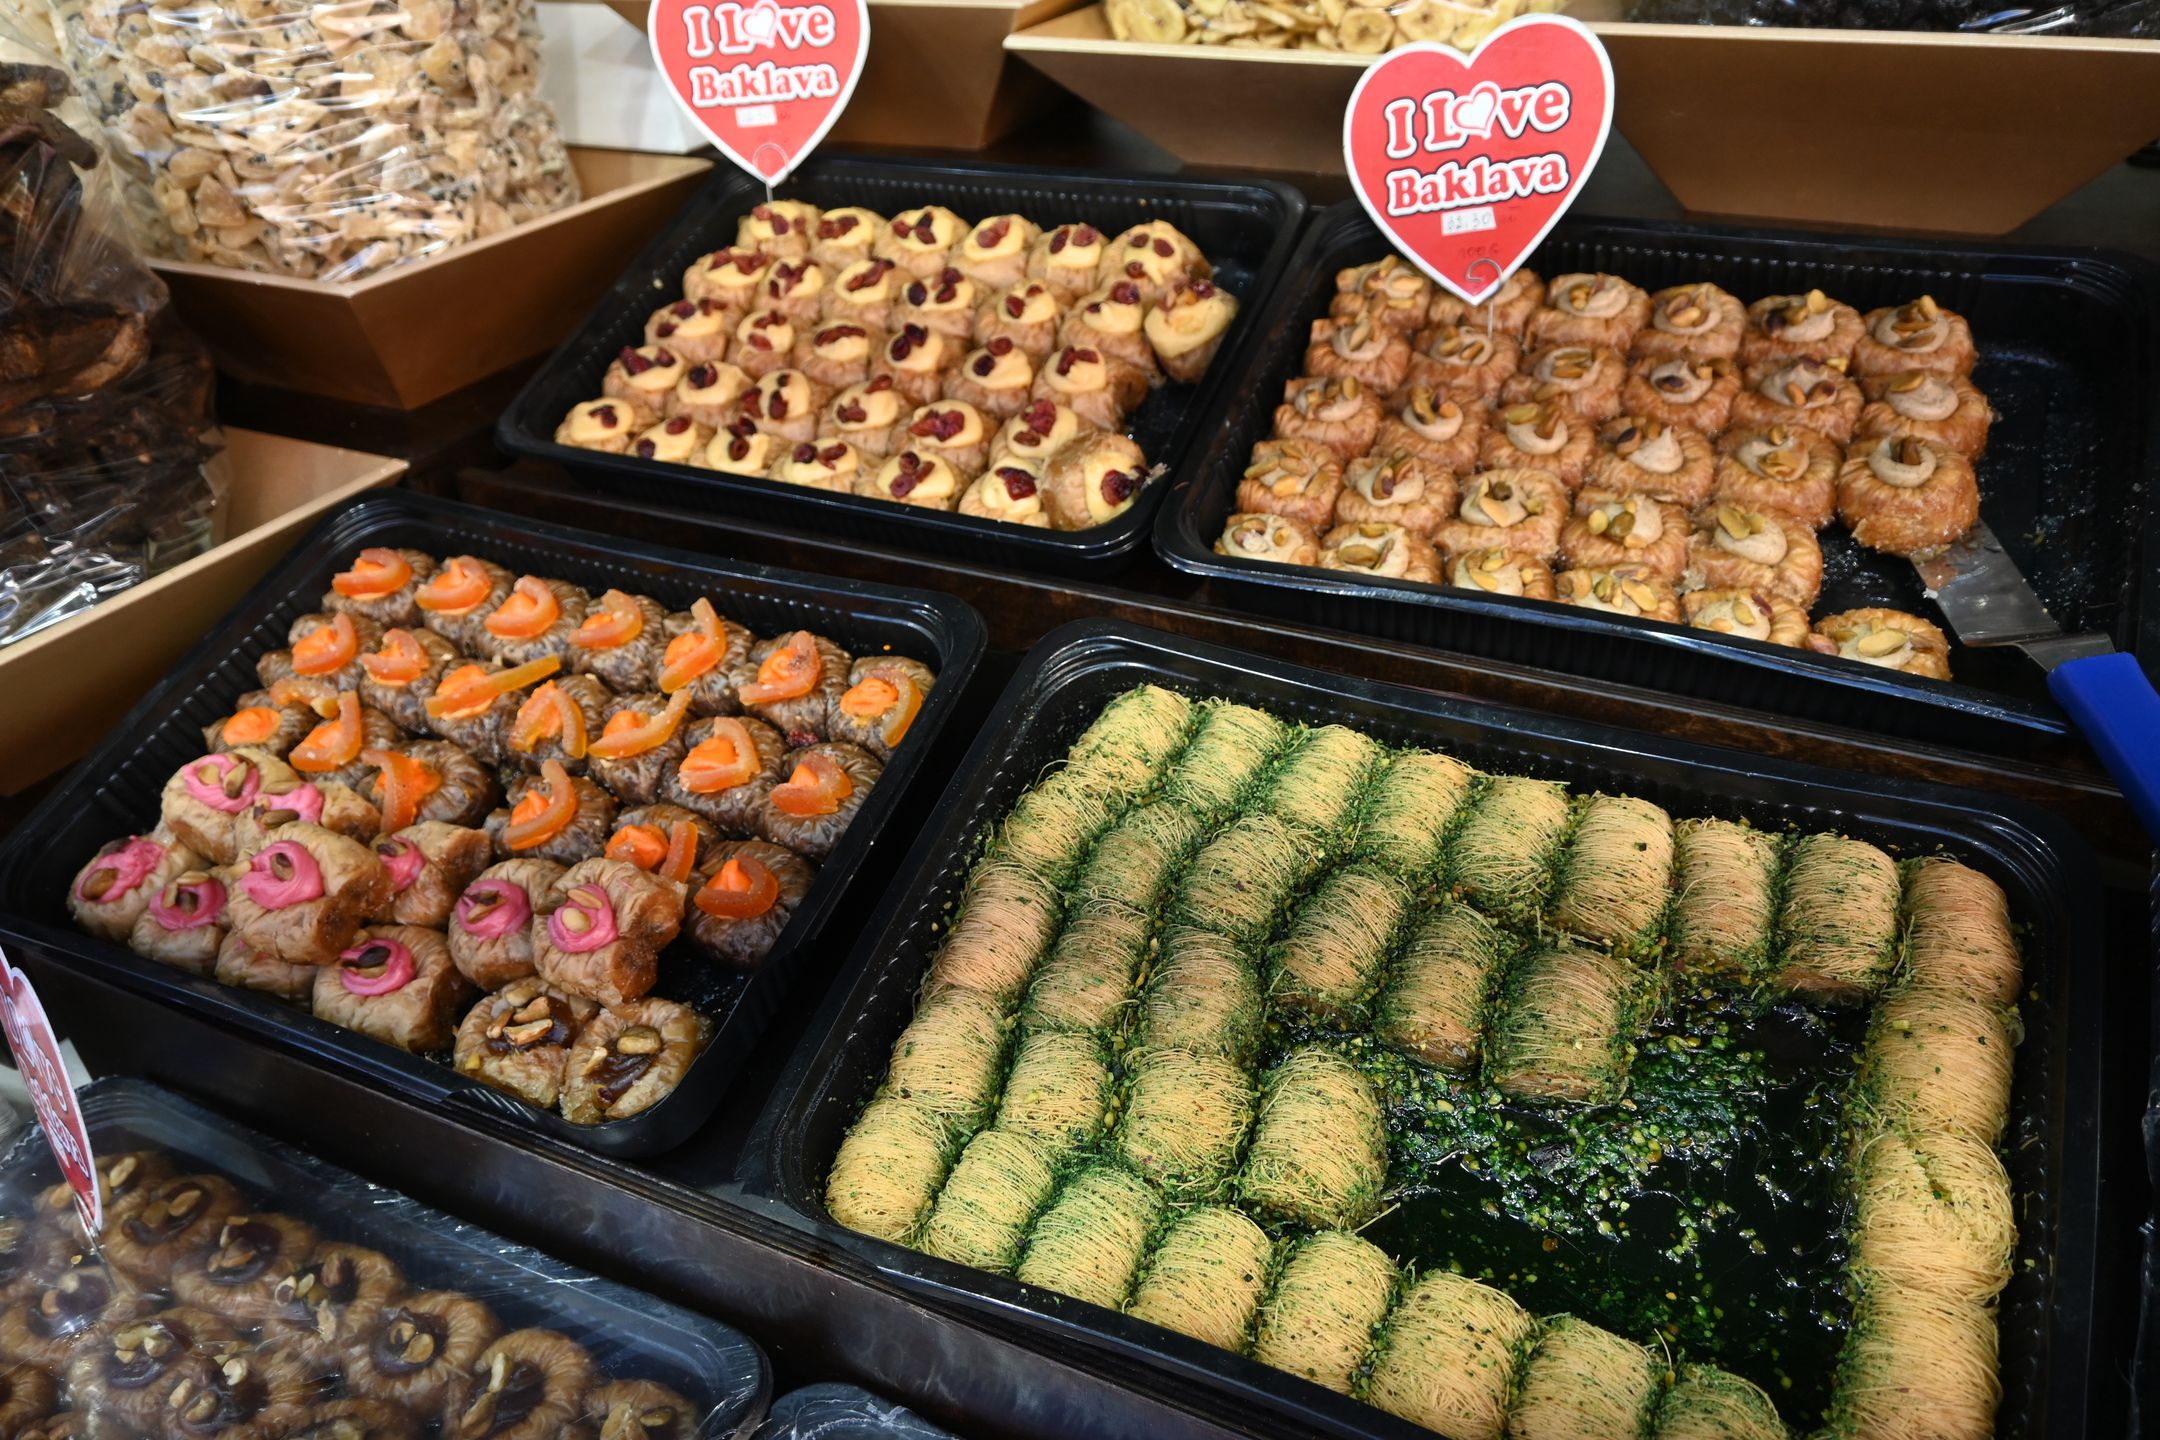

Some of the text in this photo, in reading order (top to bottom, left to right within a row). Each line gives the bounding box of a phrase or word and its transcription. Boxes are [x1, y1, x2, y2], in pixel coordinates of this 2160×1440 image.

[685, 8, 711, 55] I
[690, 63, 838, 106] Baklava
[1386, 99, 1415, 157] I
[1387, 154, 1568, 214] Baklava
